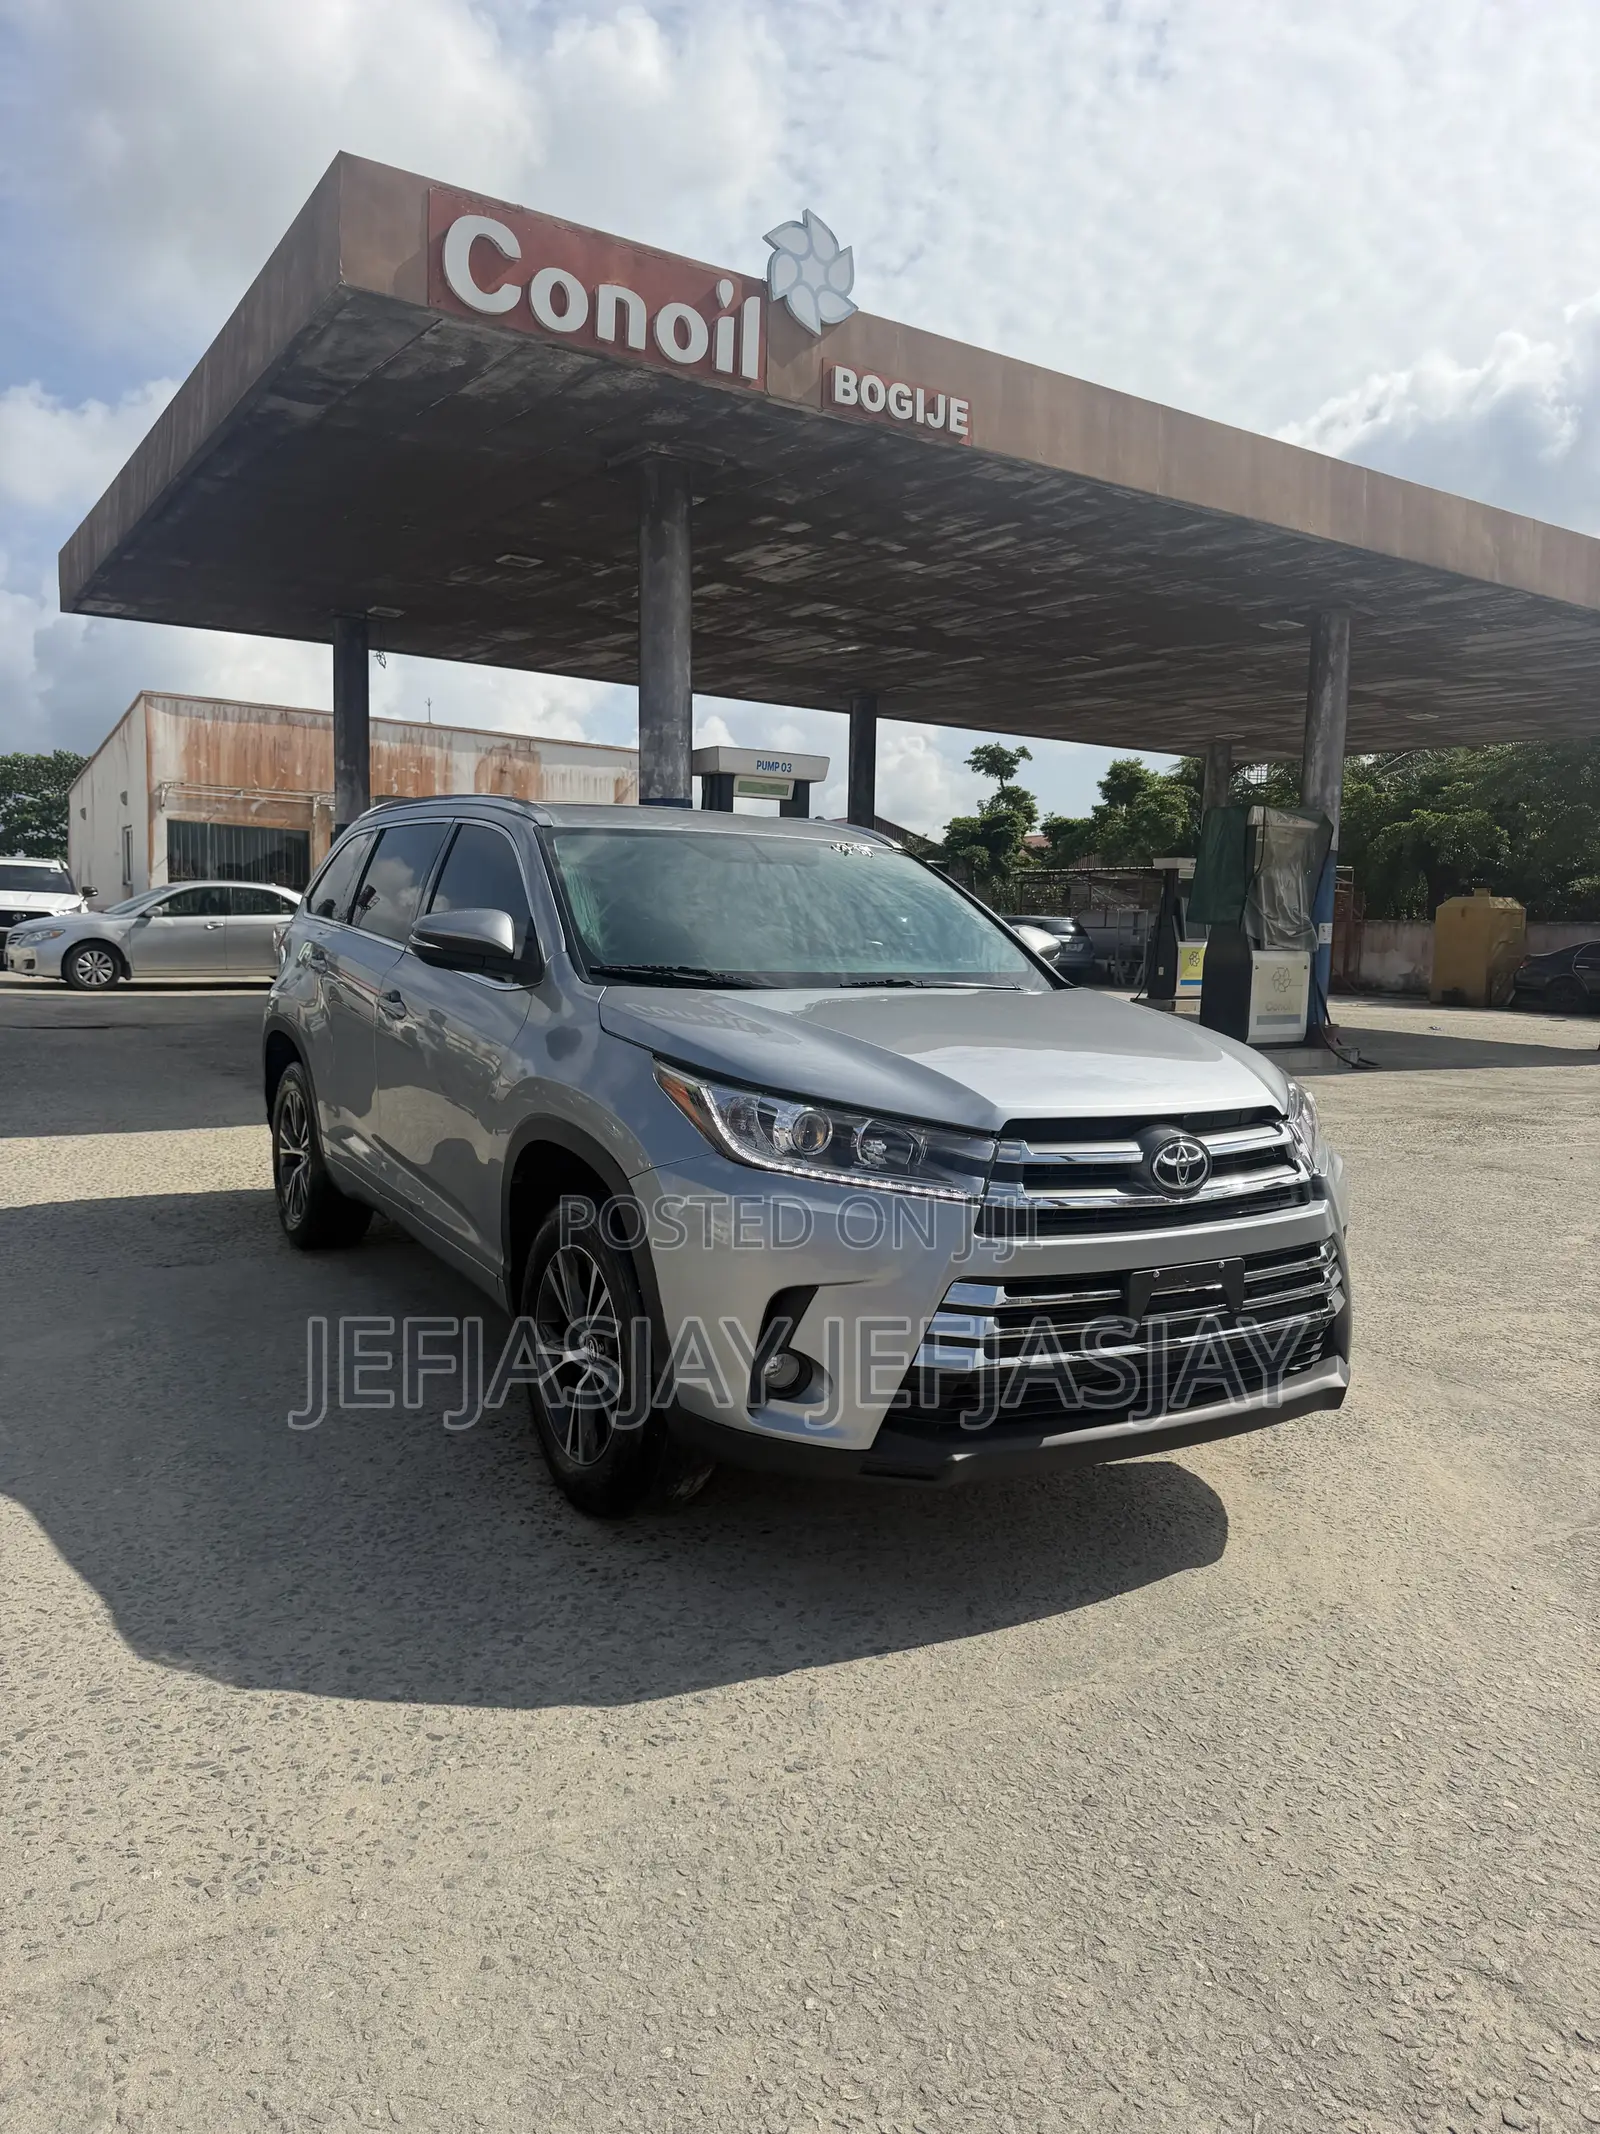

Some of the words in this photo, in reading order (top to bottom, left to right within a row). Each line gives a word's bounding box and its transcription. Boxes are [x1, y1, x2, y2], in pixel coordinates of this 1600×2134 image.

[442, 214, 761, 380] Conoil
[831, 365, 969, 436] BOGIJE
[756, 760, 780, 771] PUMP
[781, 762, 792, 773] 03
